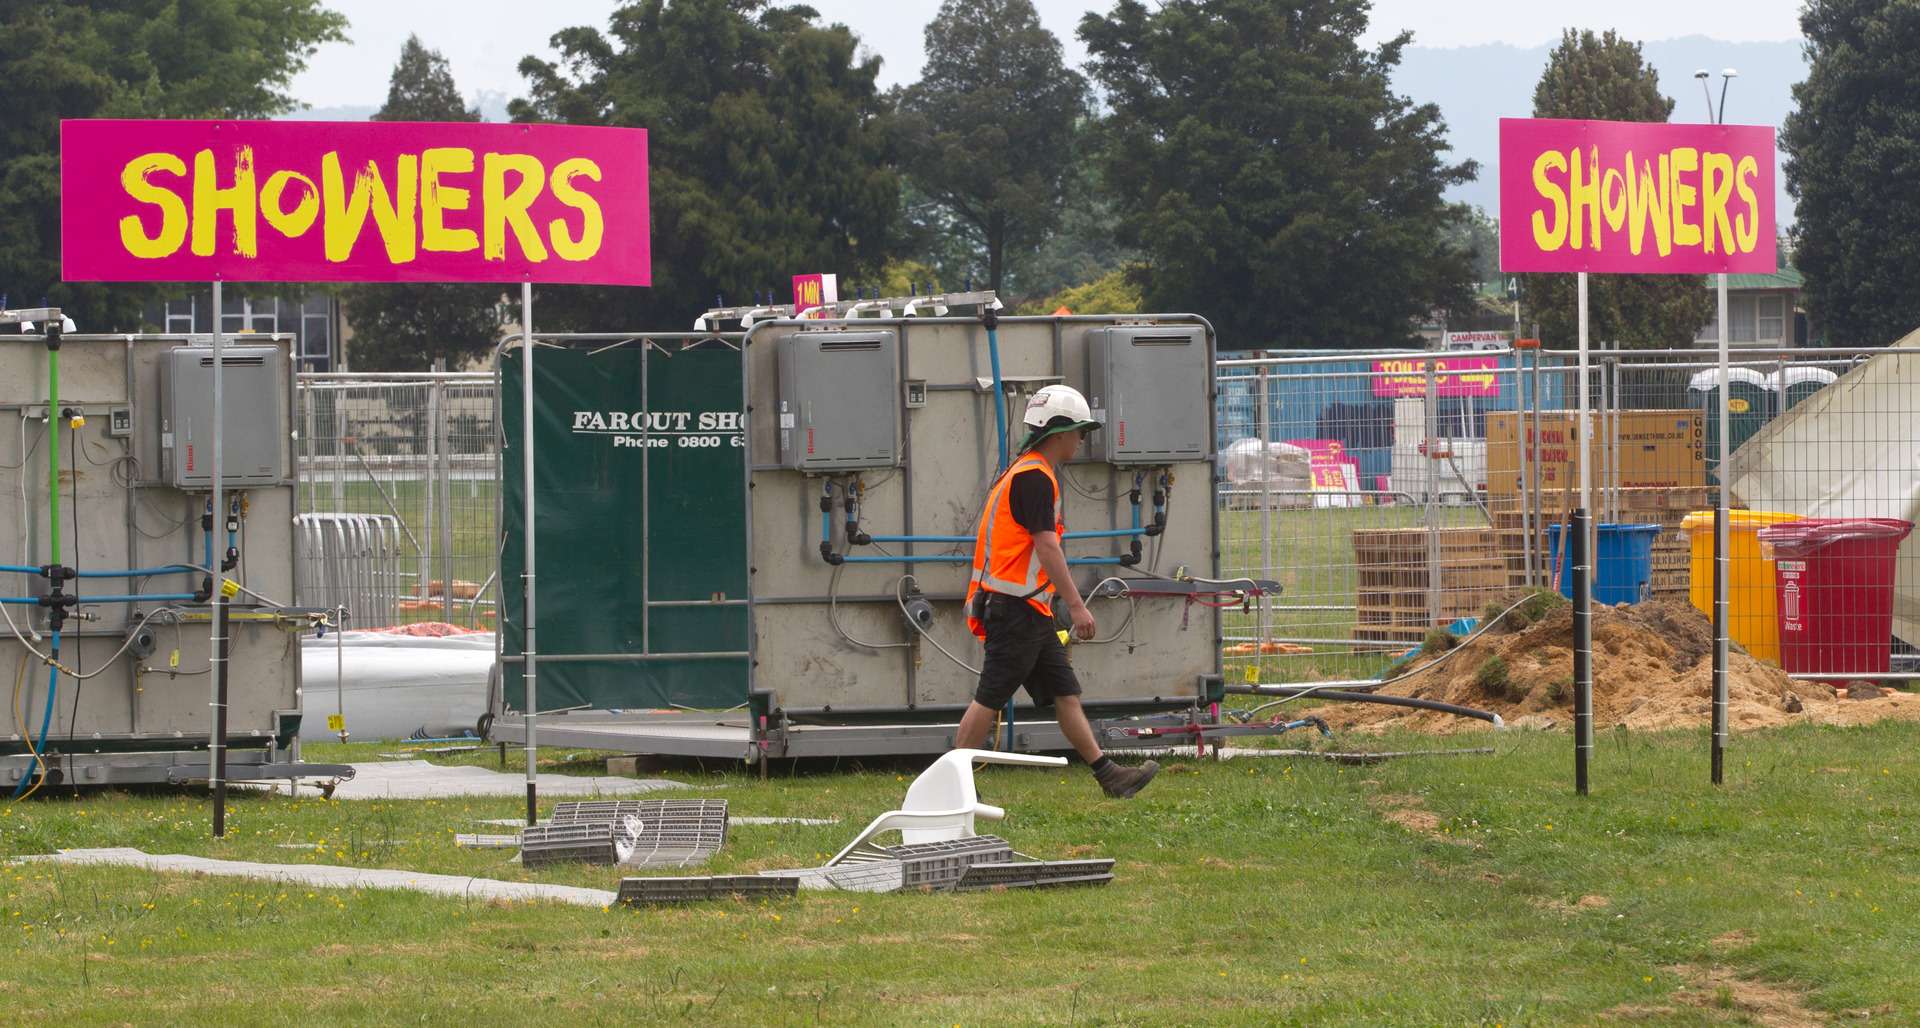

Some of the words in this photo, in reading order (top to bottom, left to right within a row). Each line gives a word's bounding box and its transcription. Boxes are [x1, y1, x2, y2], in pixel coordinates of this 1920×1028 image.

[120, 146, 603, 263] SHOWERS
[1532, 146, 1758, 257] SHOWERS
[797, 282, 803, 306] 1
[1507, 277, 1517, 293] 4
[1450, 333, 1496, 342] CAMPERVAN
[1380, 361, 1447, 385] TOILES
[572, 411, 691, 431] FAROUT
[698, 411, 745, 431] SH
[613, 436, 669, 448] Phne
[678, 436, 721, 448] 0800
[730, 436, 745, 447] 6
[186, 444, 194, 471] Rinnai
[1651, 576, 1667, 586] ULK
[1785, 621, 1802, 631] Waste
